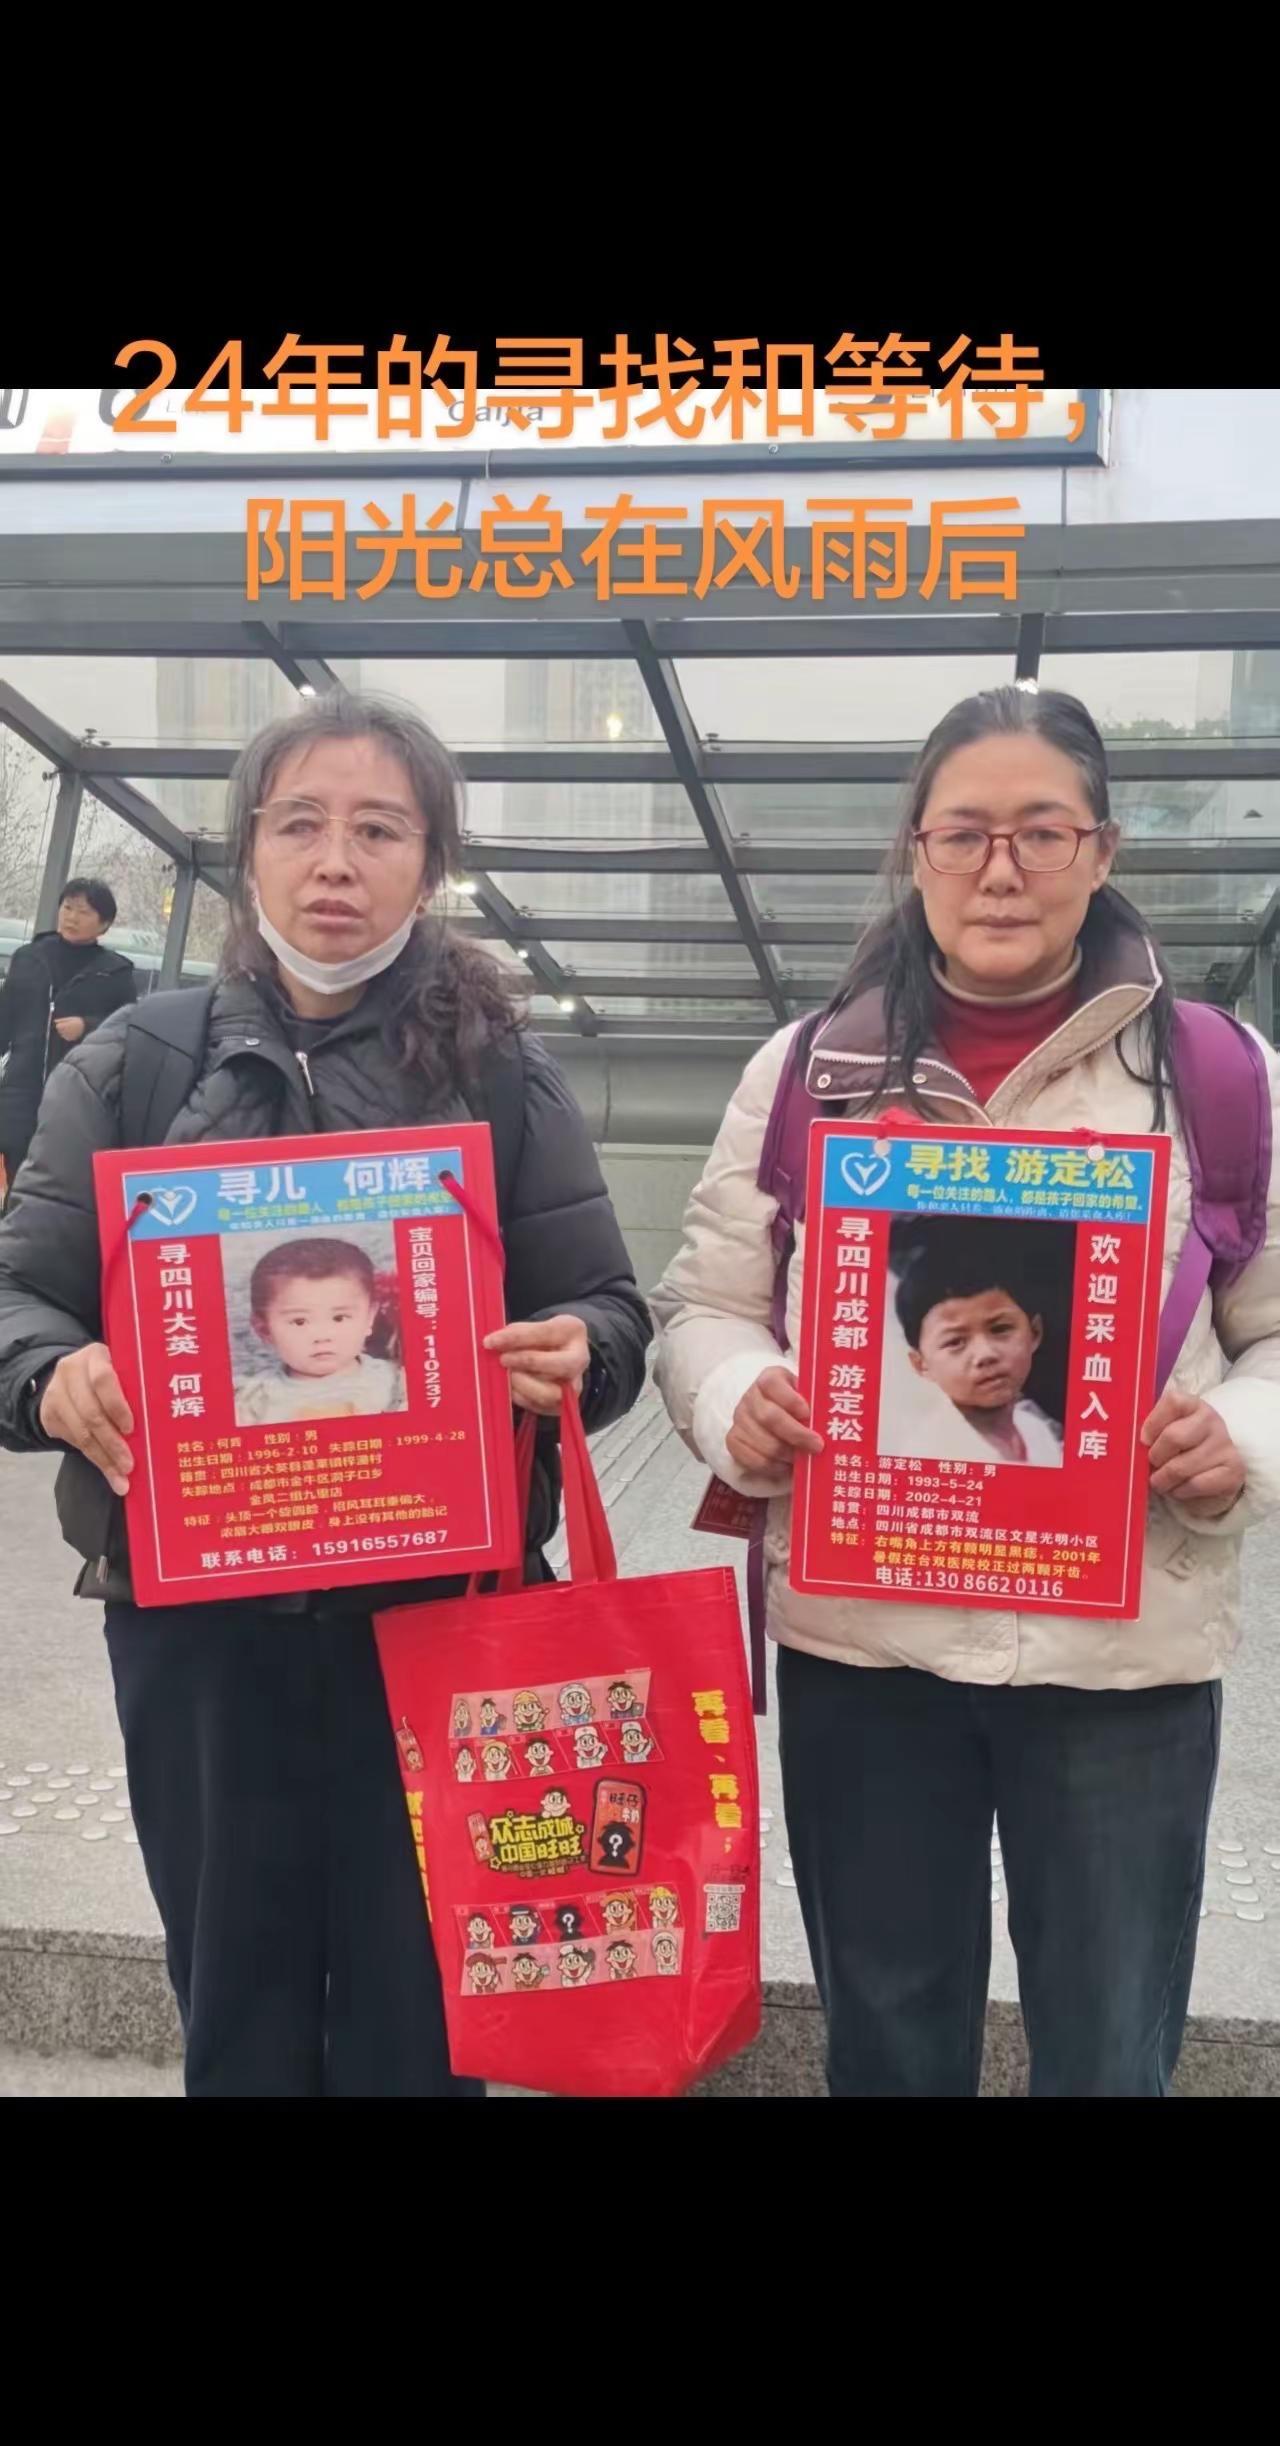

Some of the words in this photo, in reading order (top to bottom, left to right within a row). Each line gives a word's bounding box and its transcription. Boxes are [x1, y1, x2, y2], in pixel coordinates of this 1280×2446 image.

[217, 1166, 308, 1206] 寻儿
[343, 1156, 431, 1198] 何辉
[905, 1144, 990, 1182] 寻找
[1005, 1149, 1136, 1190] 游定松
[157, 1243, 200, 1357] 寻四川大英
[832, 1216, 874, 1350] 寻四川成都
[1077, 1233, 1121, 1460] 欢迎采血入库
[168, 1373, 206, 1418] 何辉
[826, 1364, 866, 1442] 游定松
[312, 1529, 448, 1556] 15916557687
[963, 1573, 1011, 1594] 8662
[1015, 1577, 1064, 1598] 0116
[490, 1815, 575, 1845] 众志成城
[500, 1835, 582, 1863] 中国旺旺
